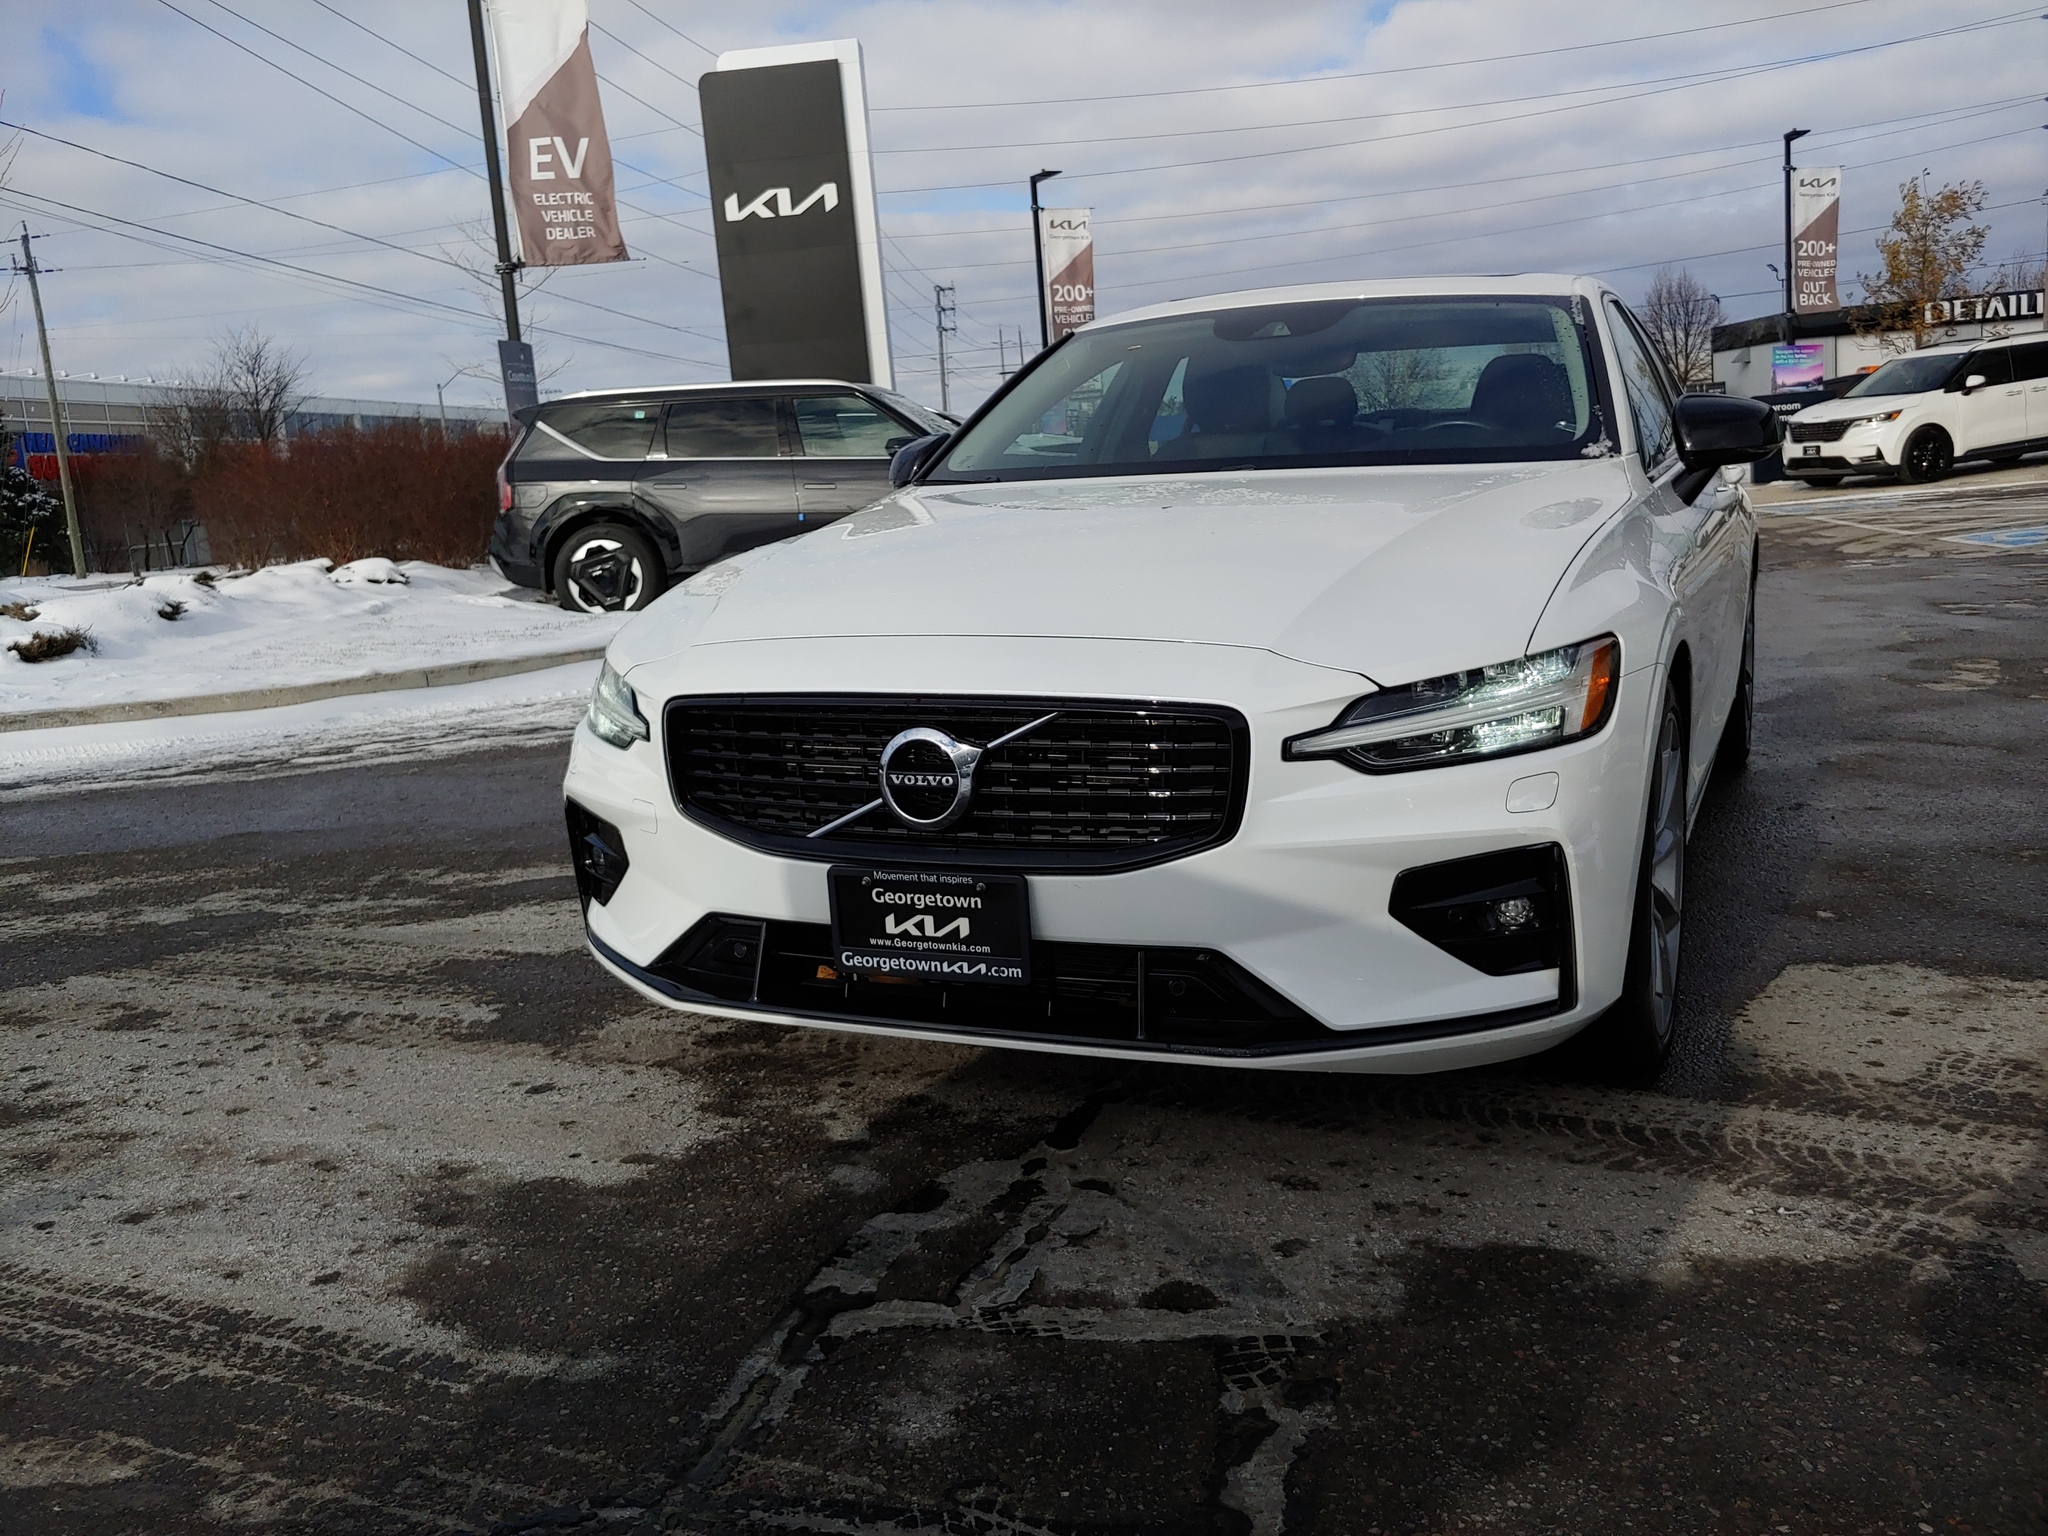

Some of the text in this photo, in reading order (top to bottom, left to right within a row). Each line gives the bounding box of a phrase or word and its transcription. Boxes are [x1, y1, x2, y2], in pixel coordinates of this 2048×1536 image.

[529, 136, 589, 180] EV
[1799, 177, 1836, 188] KIA
[533, 192, 594, 206] ELECTRIC
[724, 182, 839, 222] KIA
[541, 209, 594, 222] VEHICLE
[1049, 219, 1087, 230] KIA
[545, 226, 596, 240] DEALER
[1798, 240, 1836, 257] 200+
[1053, 284, 1094, 302] 200+
[1803, 281, 1827, 293] OUT
[1800, 293, 1833, 306] BACK
[889, 774, 954, 786] VOLVO
[873, 871, 973, 885] Movement that inspires
[871, 888, 982, 909] Georgetown
[885, 912, 970, 939] KIA
[869, 938, 991, 954] www.Georgetownkia.com
